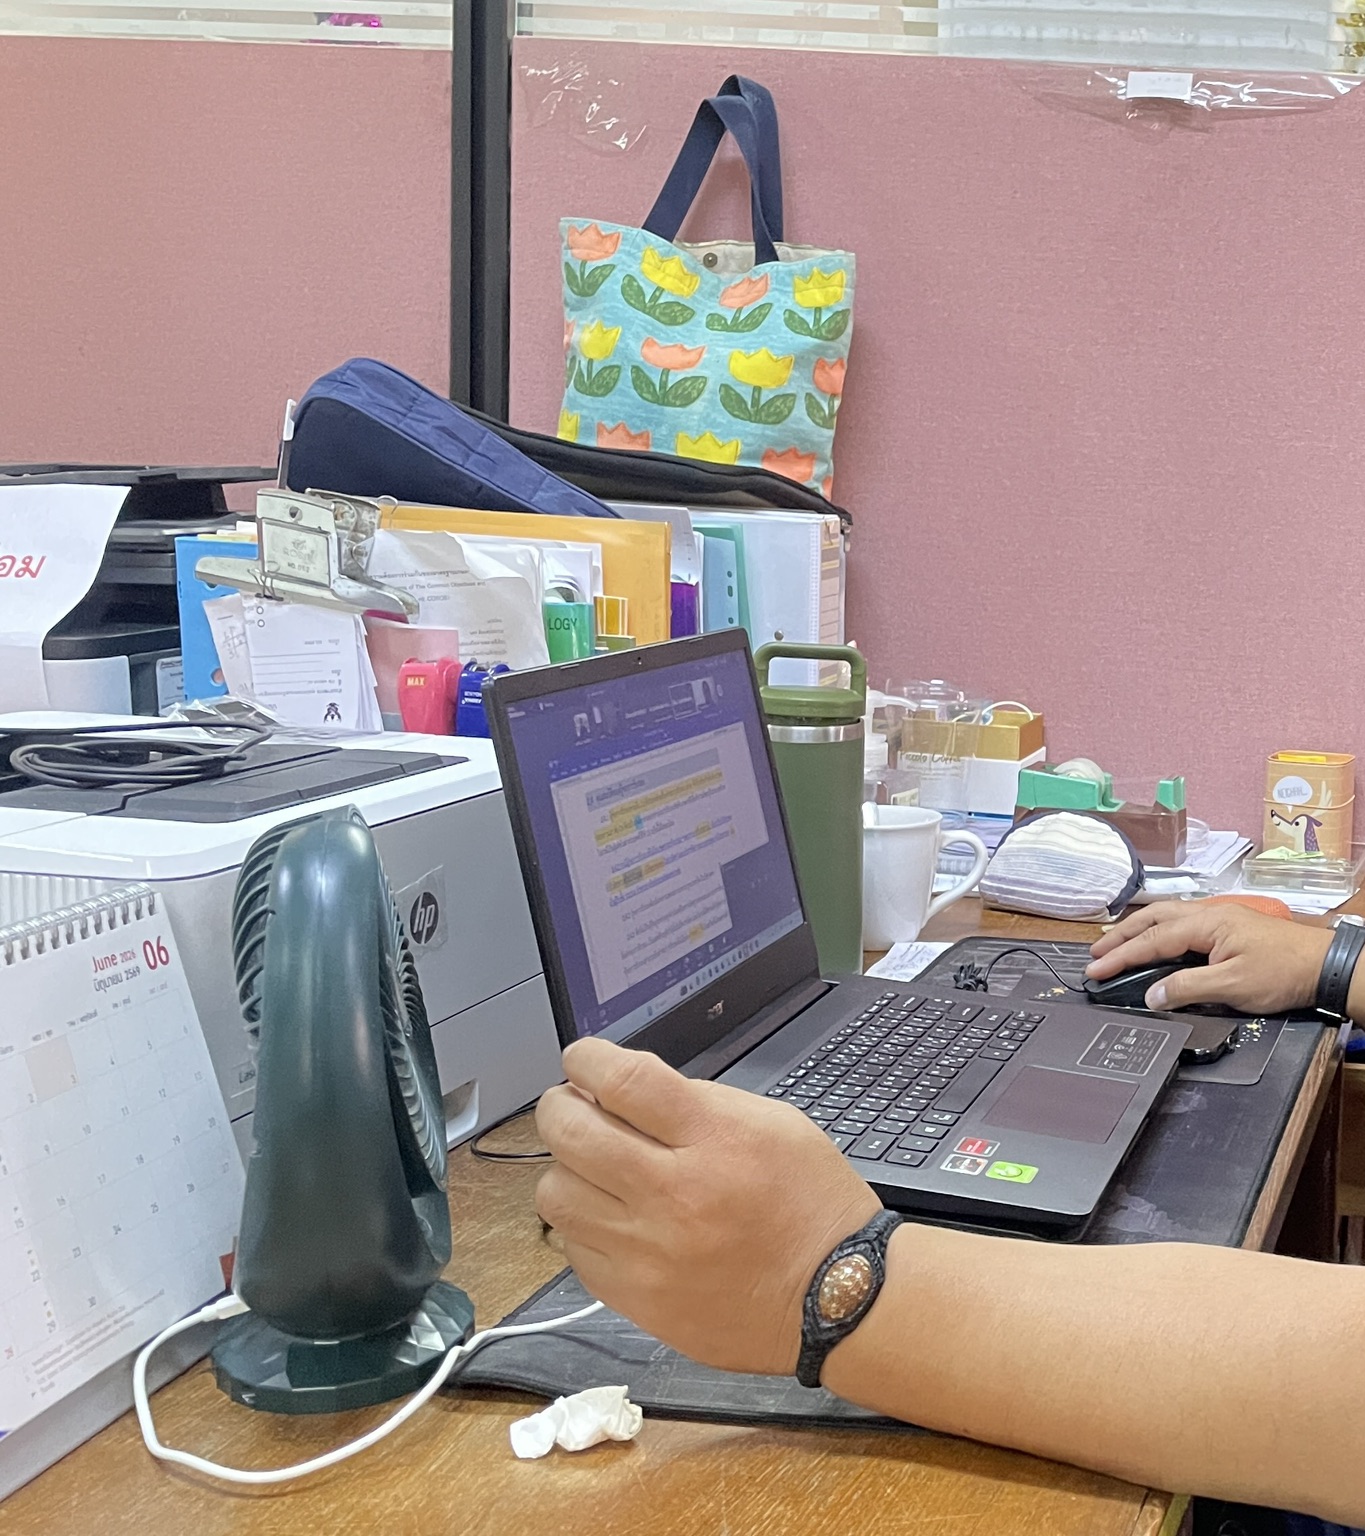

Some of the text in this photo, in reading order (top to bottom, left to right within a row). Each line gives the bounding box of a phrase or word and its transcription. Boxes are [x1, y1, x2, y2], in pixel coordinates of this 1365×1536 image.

[548, 617, 577, 631] LOGY
[406, 677, 425, 686] MAX
[411, 892, 437, 944] hp
[92, 935, 170, 973] June 2026 06
[124, 965, 141, 980] 2569
